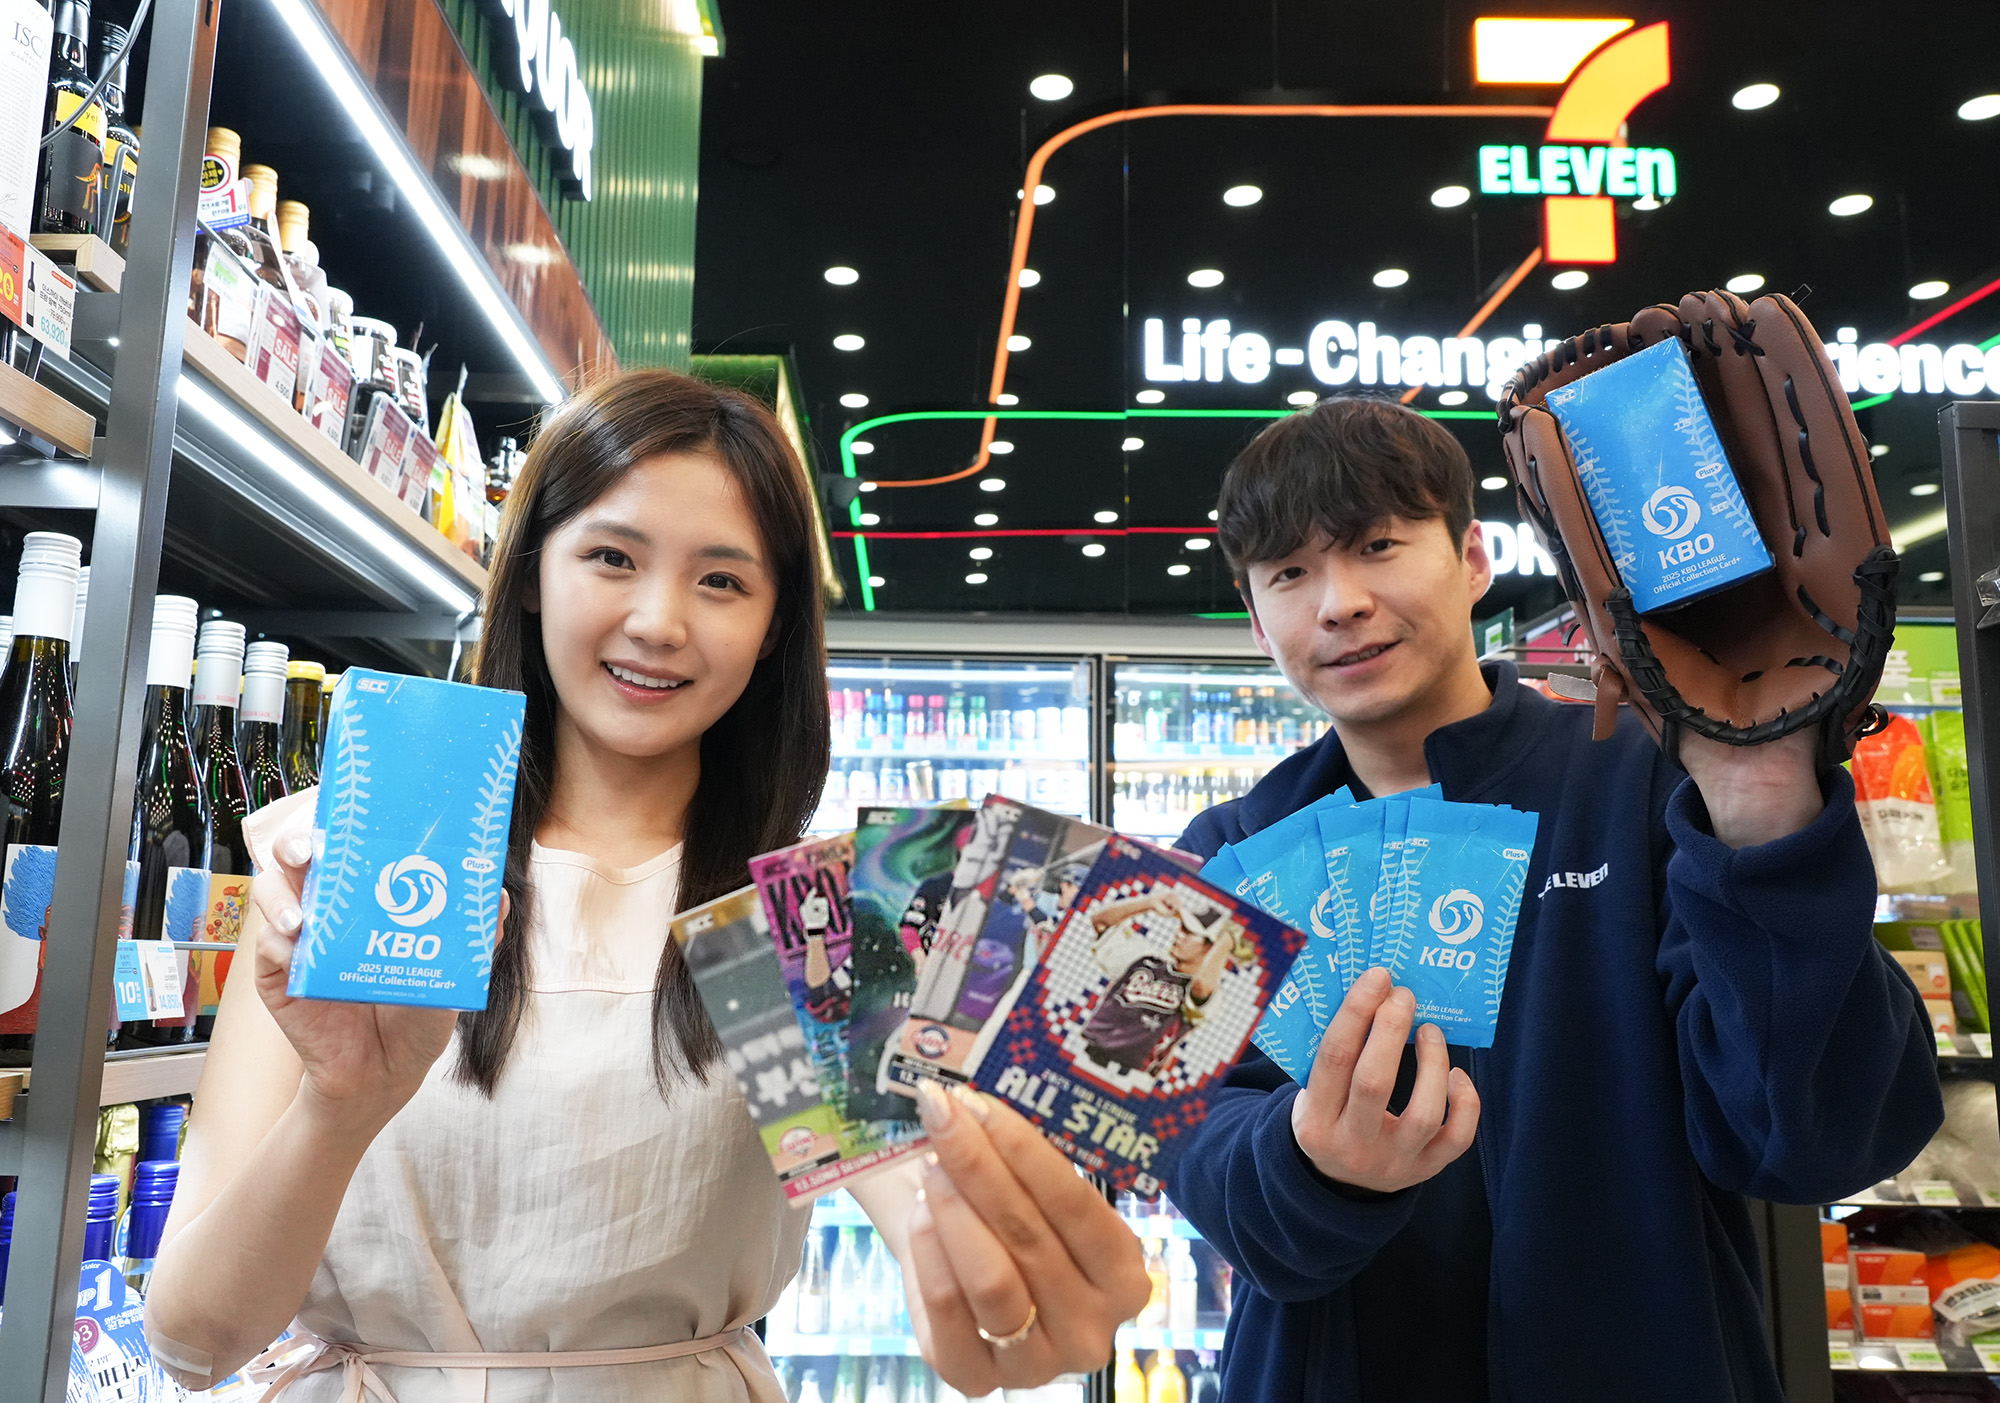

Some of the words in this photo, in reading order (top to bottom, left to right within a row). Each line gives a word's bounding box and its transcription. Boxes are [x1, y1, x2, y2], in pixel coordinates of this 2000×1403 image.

[275, 338, 298, 371] SALE
[326, 387, 347, 416] SALE
[384, 437, 402, 466] SALE
[412, 464, 431, 488] SALE
[1657, 533, 1716, 570] KBO
[1653, 580, 1682, 595] Official
[1681, 565, 1719, 584] Collection
[1719, 557, 1742, 570] Card+
[1661, 571, 1681, 584] 2025
[1680, 564, 1697, 577] KBO
[1697, 552, 1727, 570] LEAGUE
[357, 678, 388, 693] SCC
[466, 860, 491, 870] Plus+
[1505, 850, 1525, 858] Plus+
[365, 929, 442, 961] KBO
[1418, 945, 1477, 971] KBO
[339, 971, 377, 984] Official
[379, 974, 428, 988] Collection
[428, 978, 457, 989] Card+
[357, 962, 382, 974] 2025
[383, 965, 405, 976] KBO
[406, 967, 443, 979] LEAGUE
[118, 981, 137, 1005] 10
[1268, 980, 1301, 1019] KB
[1423, 1012, 1454, 1021] Collection
[1454, 1015, 1472, 1023] Card+
[1425, 1004, 1440, 1012] KBO
[1440, 1006, 1464, 1015] LEAGUE
[994, 1064, 1059, 1119] ALL
[1062, 1100, 1160, 1170] STAR
